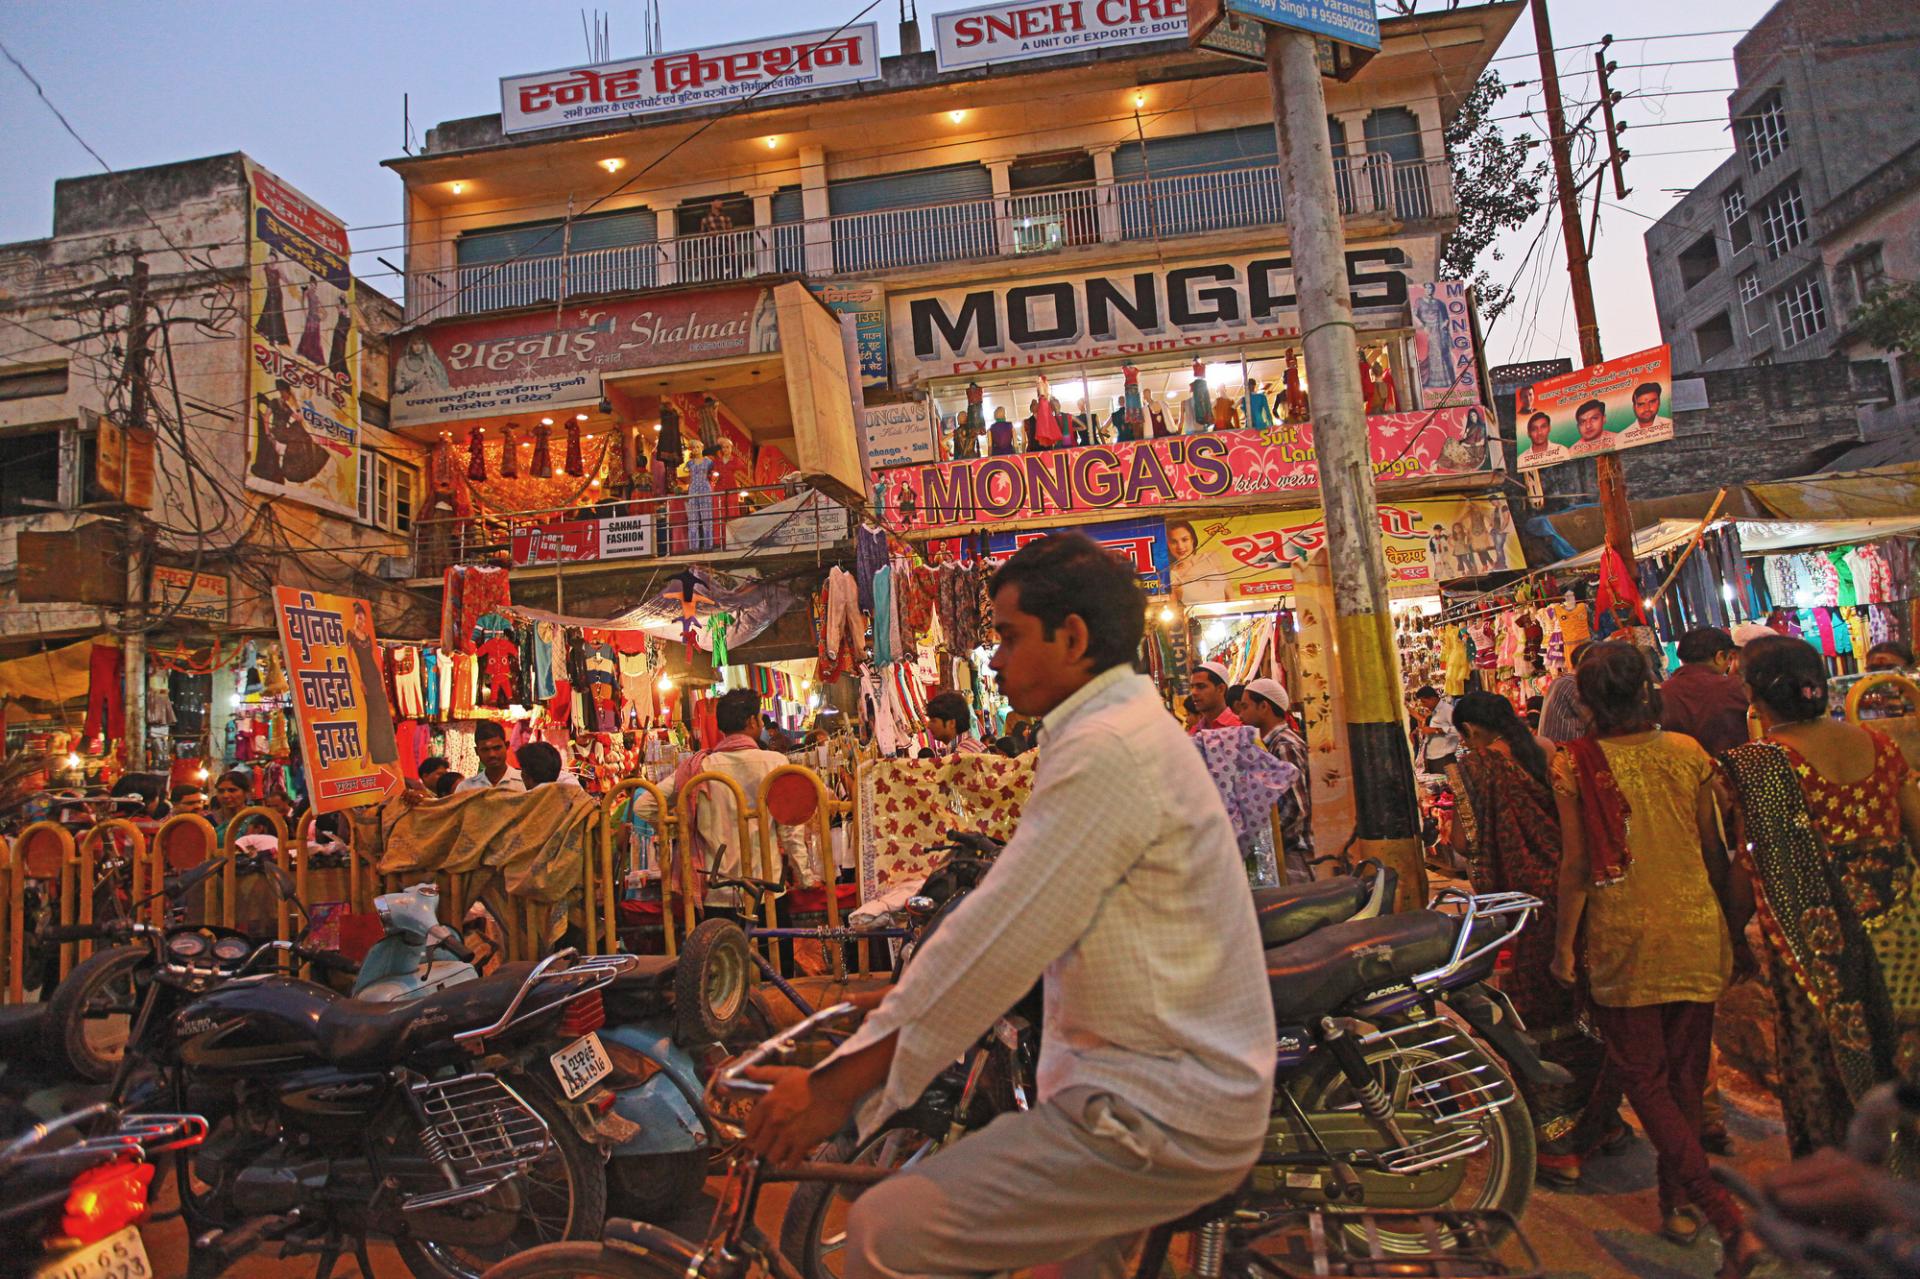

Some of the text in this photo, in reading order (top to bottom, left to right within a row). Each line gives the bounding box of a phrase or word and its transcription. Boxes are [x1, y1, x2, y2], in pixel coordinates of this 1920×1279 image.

[954, 0, 1087, 48] SNEH
[1279, 0, 1309, 18] Singh
[1020, 42, 1030, 51] A
[1033, 36, 1060, 49] UNIT
[1063, 34, 1080, 45] OF
[1084, 26, 1137, 43] EXPORT
[1139, 25, 1149, 35] &
[518, 36, 863, 114] स्नेह क्रिएशन
[448, 312, 607, 373] शहनाई
[617, 310, 749, 350] Shahnai
[253, 343, 352, 409] शहनाई
[864, 402, 927, 429] ONGA'S
[1258, 427, 1299, 447] Suit
[920, 436, 1233, 525] MONGA'S
[1234, 472, 1317, 492] kids wear
[606, 531, 644, 545] FASHION
